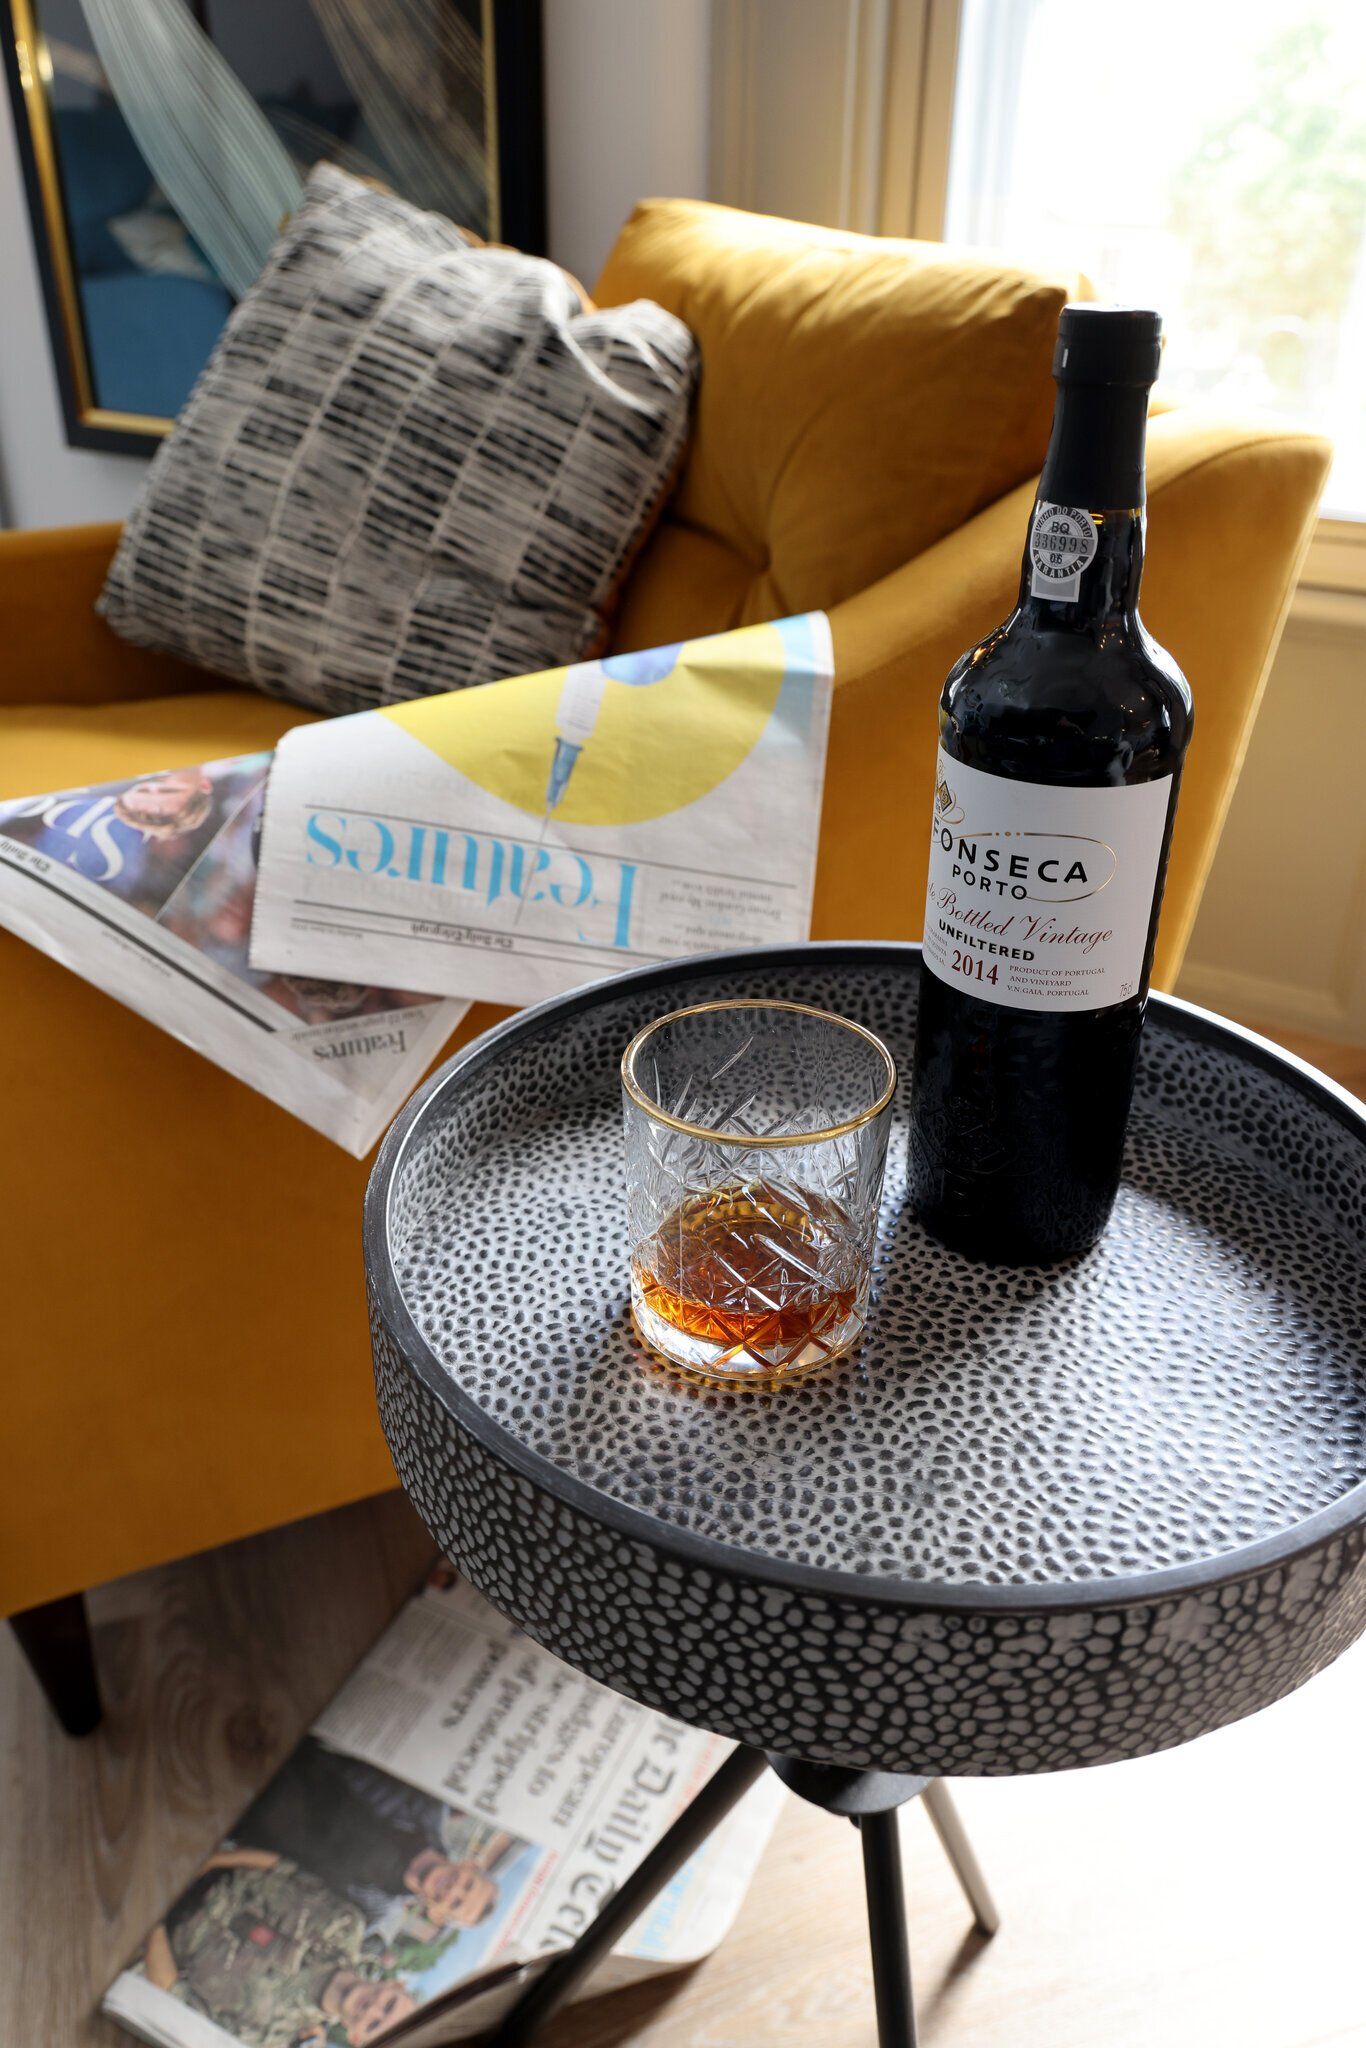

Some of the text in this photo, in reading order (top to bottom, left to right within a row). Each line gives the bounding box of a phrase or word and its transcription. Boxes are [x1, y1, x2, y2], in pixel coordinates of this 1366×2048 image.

[1035, 506, 1093, 537] VINHO DO PORTO
[1051, 521, 1070, 535] BQ
[1034, 553, 1084, 578] GARANTIA
[932, 817, 1089, 884] FONSECA
[306, 812, 638, 949] Features
[952, 864, 1028, 900] PORTO
[411, 921, 463, 942] Telegraph
[936, 887, 1015, 937] Bottled
[1020, 915, 1113, 954] Vintage
[466, 930, 492, 946] Daily
[939, 919, 1035, 962] UNFILTERED
[951, 949, 999, 986] 2014
[1009, 965, 1051, 976] PRODUCT
[1065, 967, 1106, 976] PORTUGAL
[1010, 976, 1028, 984] AND
[312, 1029, 406, 1059] Features
[473, 1703, 550, 1816] stripped
[527, 1765, 557, 1797] to
[584, 1757, 675, 1865] Daily
